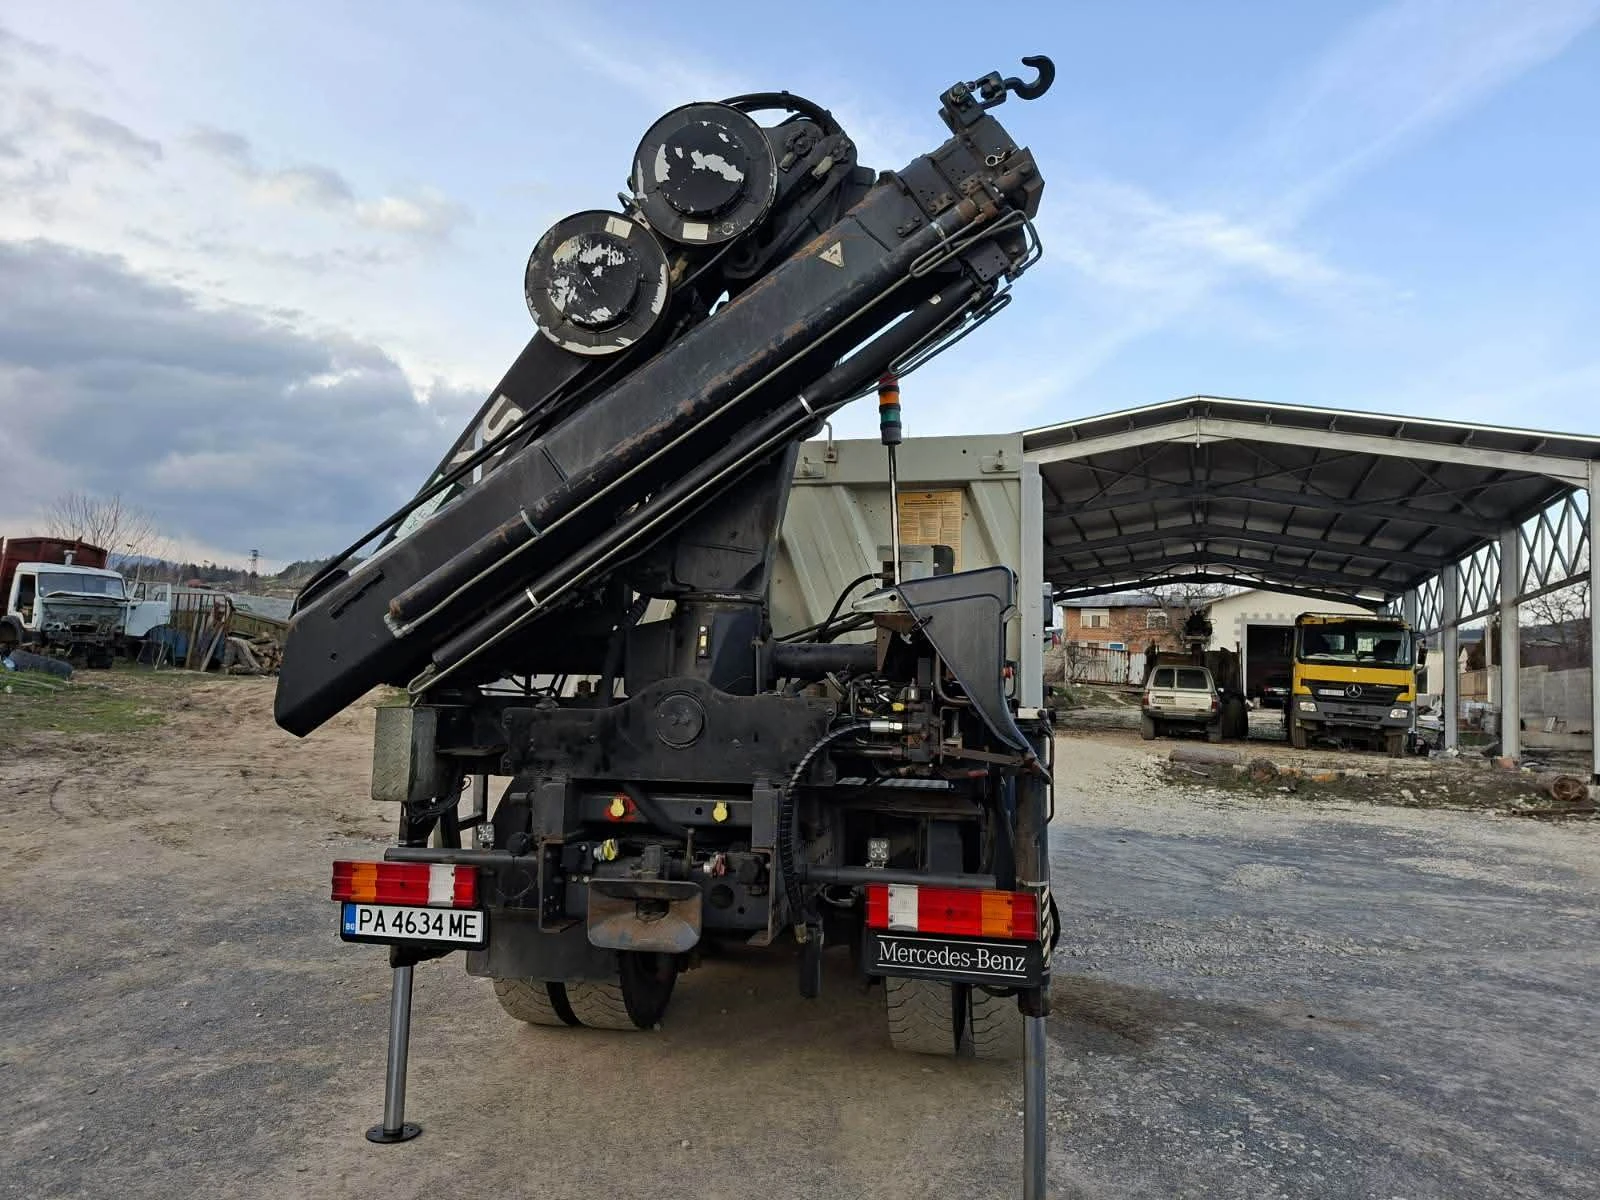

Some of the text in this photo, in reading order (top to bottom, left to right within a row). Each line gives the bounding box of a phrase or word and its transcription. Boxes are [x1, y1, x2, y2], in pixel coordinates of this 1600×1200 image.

[360, 909, 477, 938] PA 4634 ME
[878, 941, 1026, 972] Mercedes-Benz
